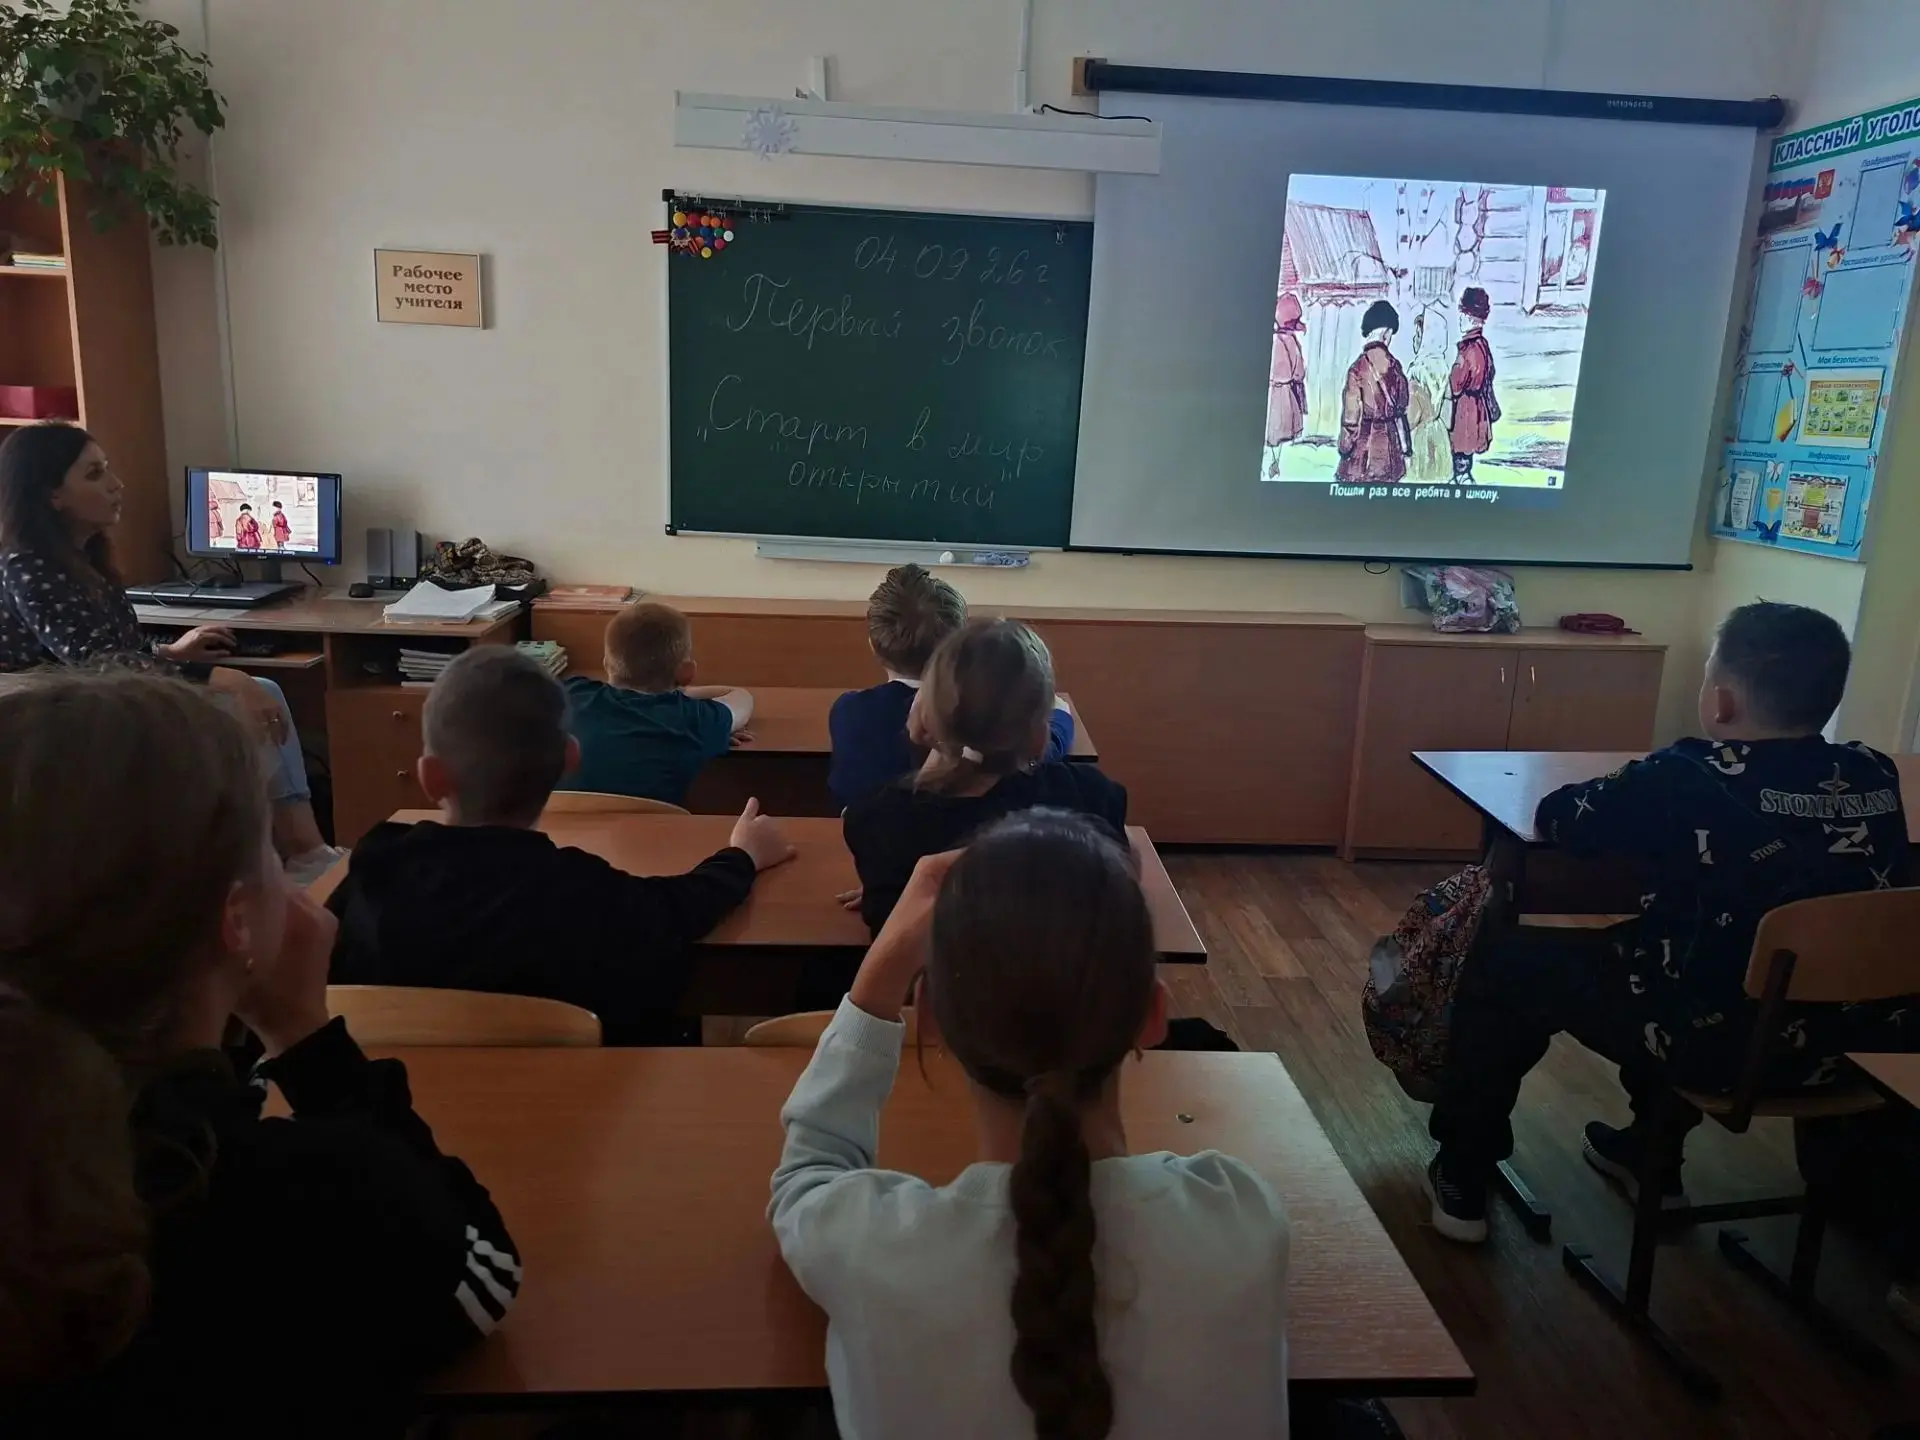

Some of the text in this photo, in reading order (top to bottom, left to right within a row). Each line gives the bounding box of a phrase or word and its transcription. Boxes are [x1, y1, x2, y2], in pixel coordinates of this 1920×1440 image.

[1774, 117, 1863, 165] КЛАССНЫЙ
[392, 264, 464, 281] Рабочее
[404, 282, 453, 295] место
[394, 296, 464, 310] учителя
[942, 298, 1067, 366] звонок
[905, 405, 932, 452] в
[948, 432, 1045, 479] мир
[1329, 483, 1500, 504] Пошли раз все ребята в школу.
[1760, 788, 1898, 818] STONE ISLAND
[1750, 838, 1787, 863] STONE
